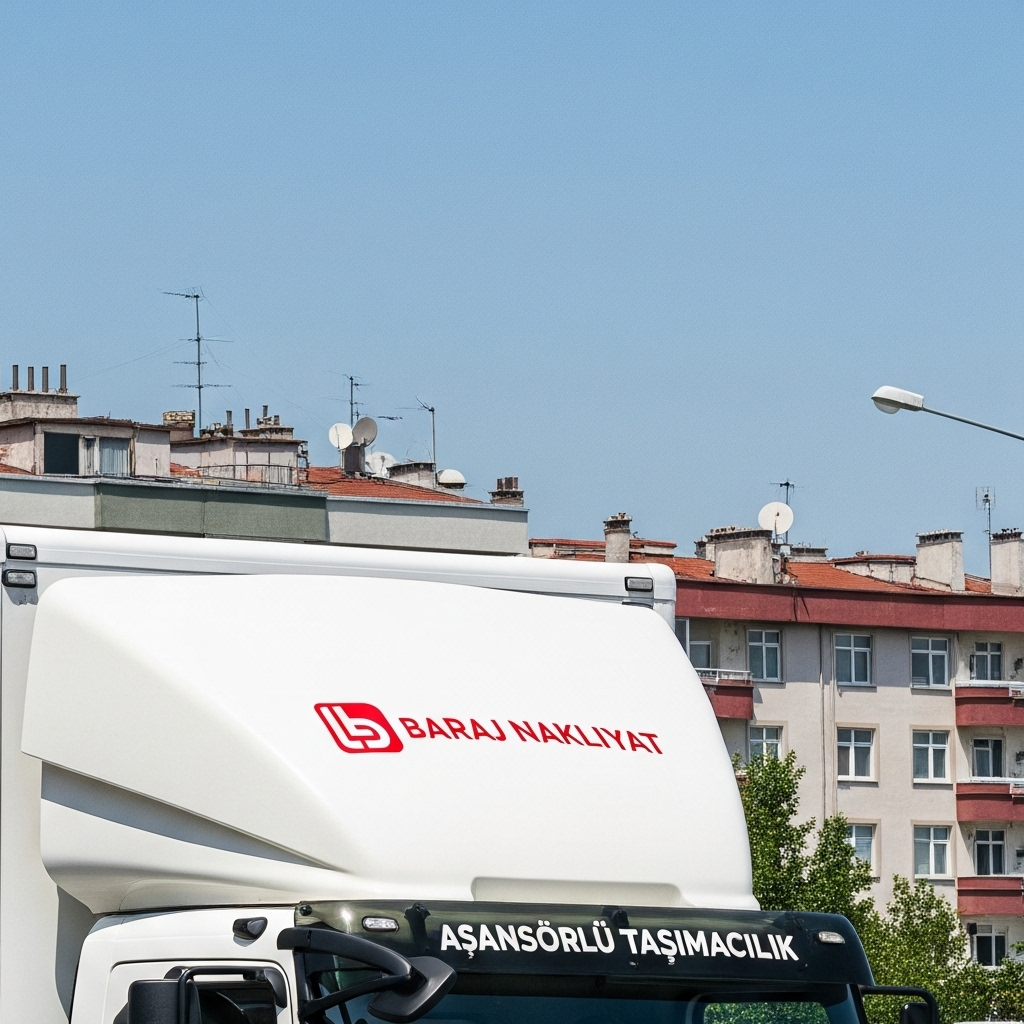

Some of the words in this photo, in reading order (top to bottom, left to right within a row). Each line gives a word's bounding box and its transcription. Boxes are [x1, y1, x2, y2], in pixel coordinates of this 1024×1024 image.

[398, 717, 507, 741] BARAJ
[507, 719, 663, 754] NAKLIYAT
[619, 928, 800, 966] TAŞIMACILIK
